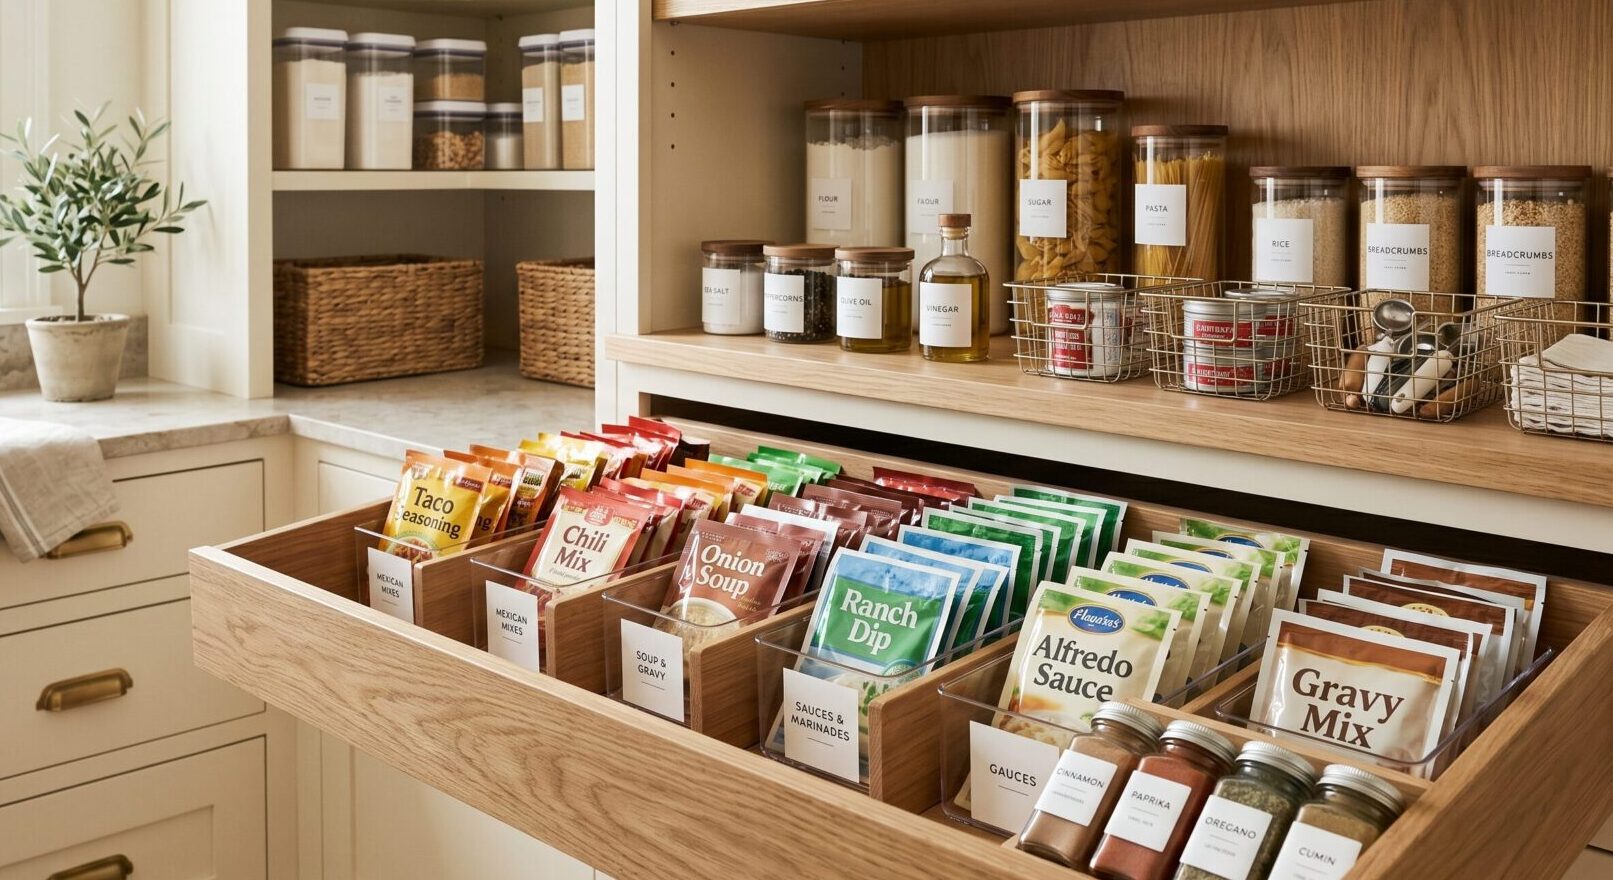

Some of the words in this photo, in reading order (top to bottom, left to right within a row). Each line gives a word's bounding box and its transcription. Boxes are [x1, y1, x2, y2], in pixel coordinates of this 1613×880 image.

[818, 195, 838, 203] FLOUR
[1027, 197, 1052, 207] SUGAR
[1145, 204, 1168, 213] PASTA
[1271, 239, 1291, 248] RICE
[1487, 249, 1554, 260] BREADCRUMBS
[714, 287, 729, 295] SALT
[859, 298, 872, 307] OIL
[926, 304, 959, 314] VINEGAR
[414, 486, 454, 516] Taco
[394, 504, 461, 542] easoning
[563, 525, 611, 553] Chili
[553, 546, 592, 573] Mix
[700, 544, 766, 577] Onion
[376, 572, 404, 589] MEXICAN
[381, 584, 401, 599] MIXES
[696, 564, 750, 600] Soup
[495, 606, 528, 626] MEXICAN
[839, 588, 919, 630] Ranch
[501, 621, 524, 637] MIXES
[847, 619, 893, 656] Dip
[636, 649, 659, 667] SOUP
[660, 658, 668, 669] &
[1032, 634, 1134, 679] Alfredo
[638, 663, 667, 682] GRAVY
[1032, 661, 1114, 704] Sauce
[1292, 667, 1405, 725] Gravy
[795, 701, 834, 723] SAUCES
[836, 714, 845, 726] &
[790, 714, 851, 743] MARINADES
[1299, 703, 1376, 750] Mix
[989, 763, 1038, 787] GAUCES
[1056, 767, 1105, 789] CINNAMON
[1131, 790, 1172, 810] PAPRIKA
[1204, 816, 1258, 840] OREGANO
[1298, 847, 1337, 866] CUMIN
